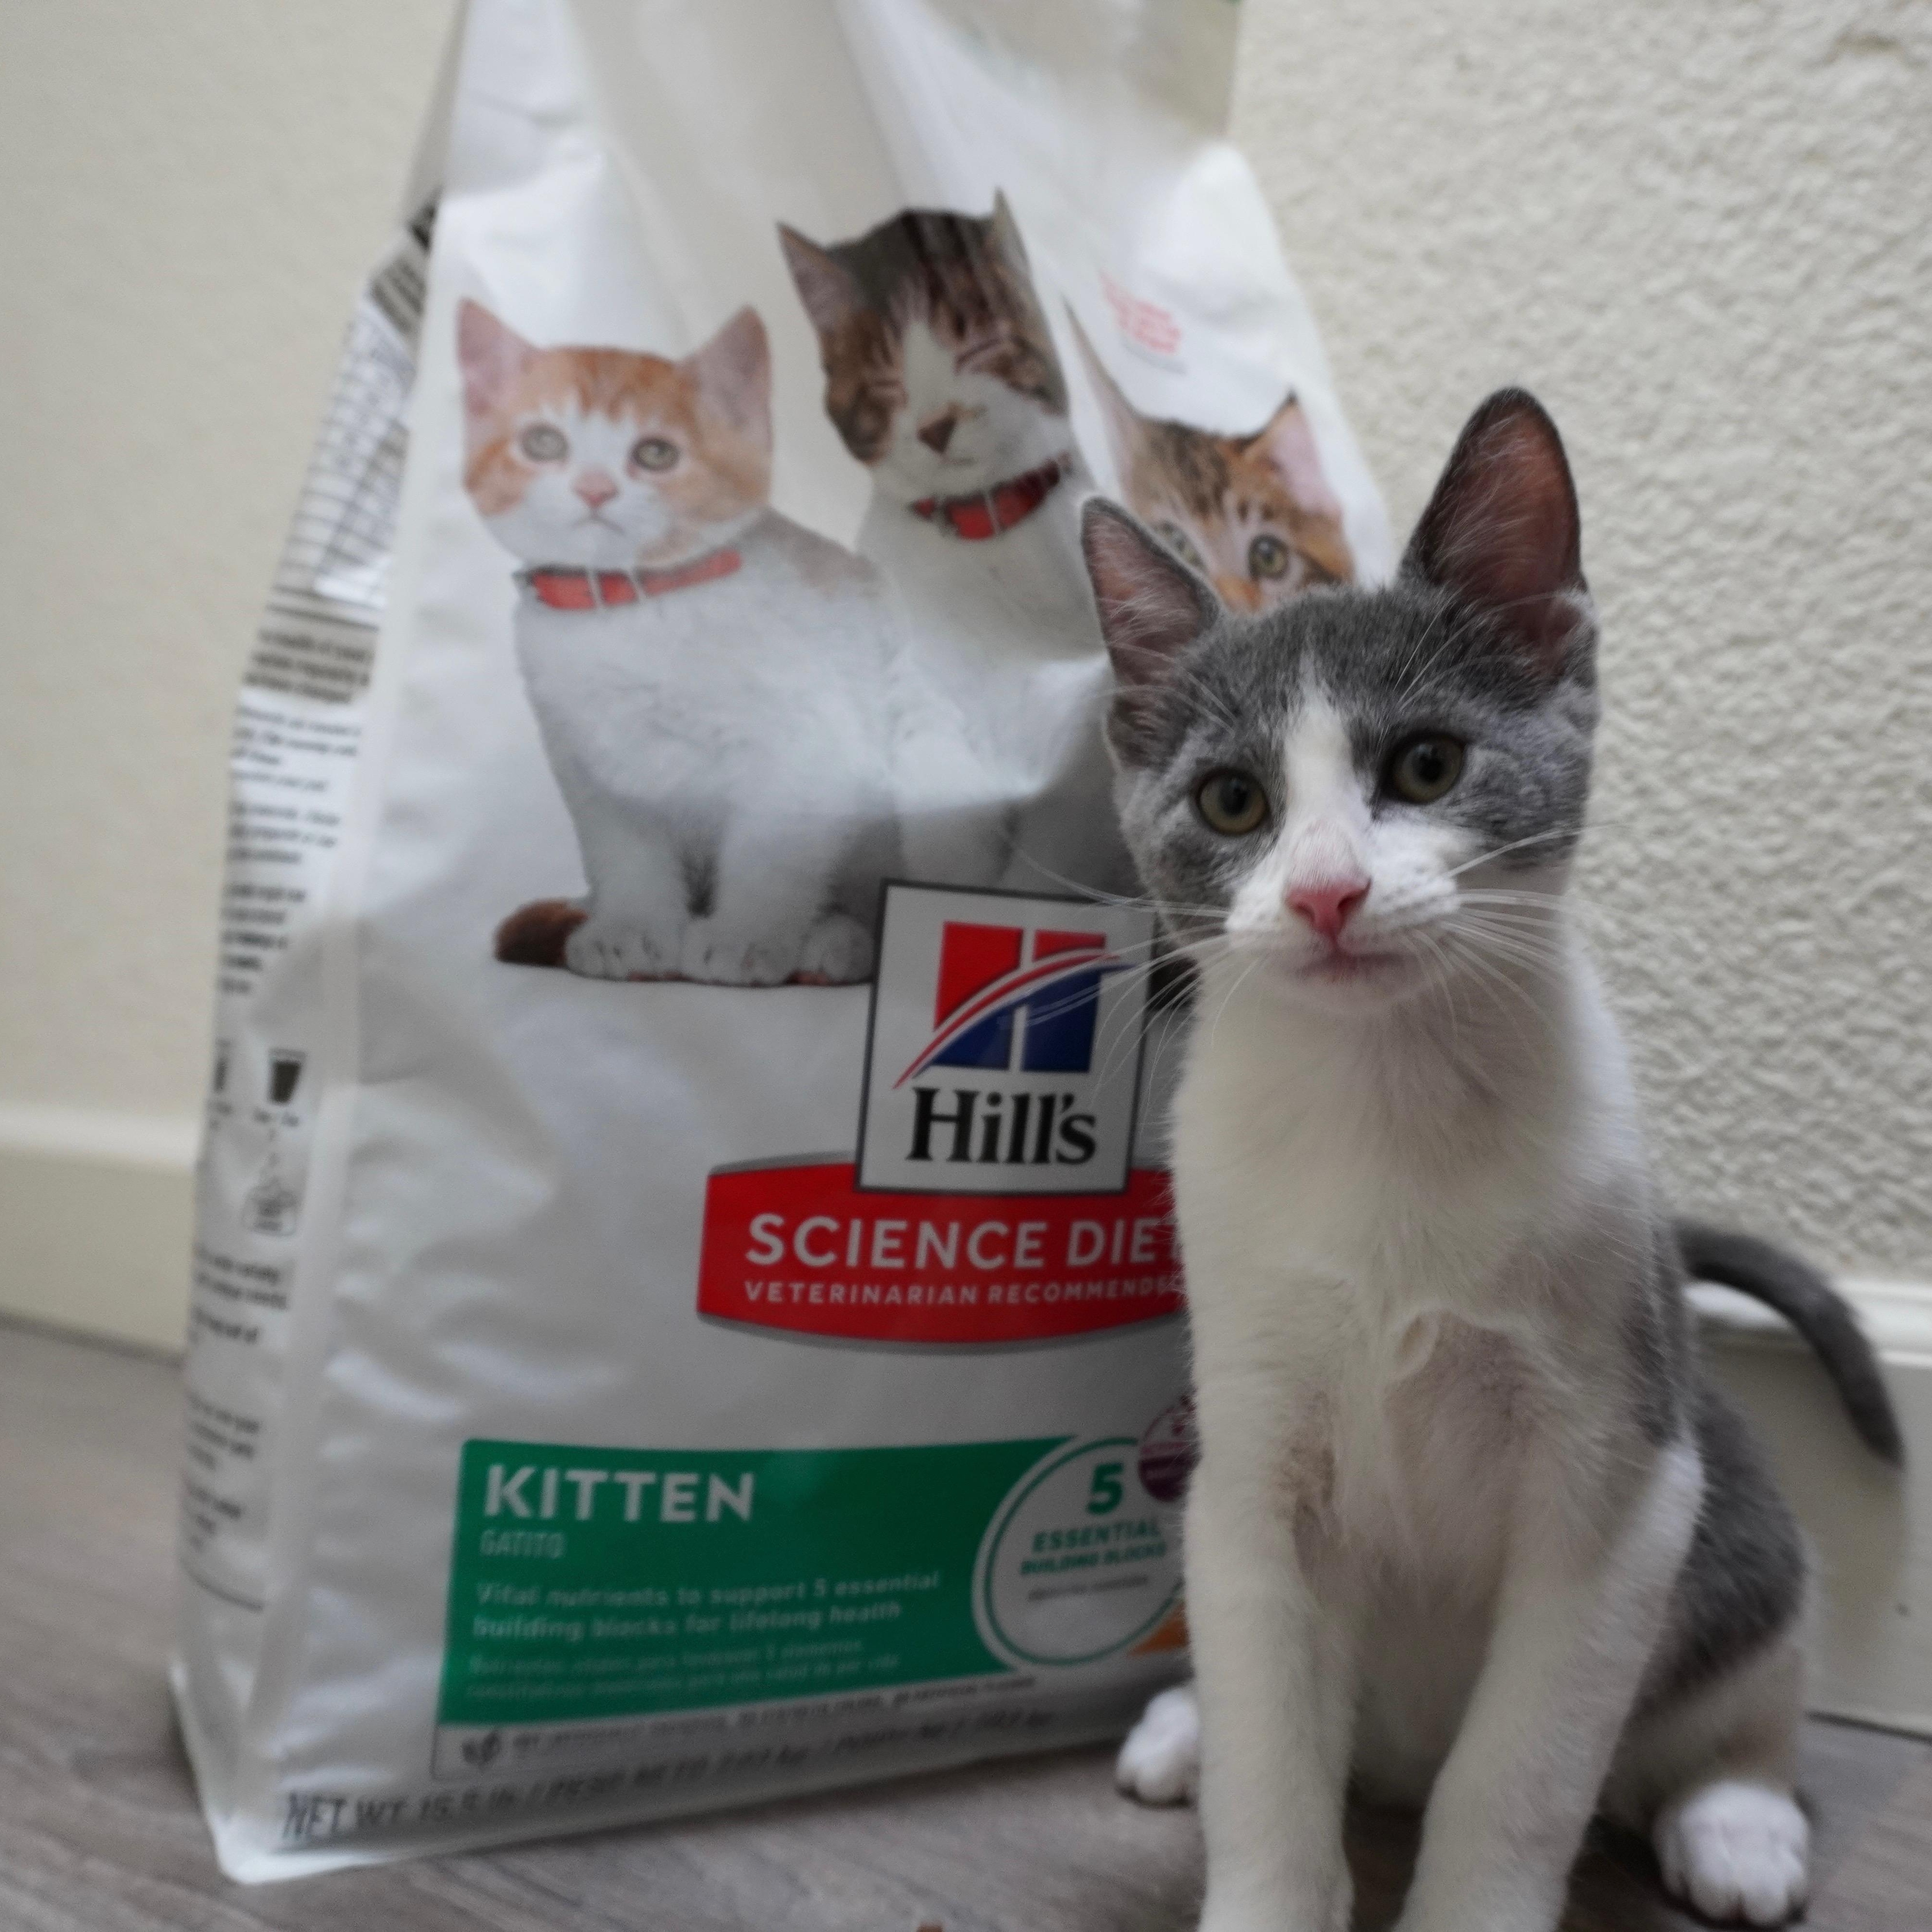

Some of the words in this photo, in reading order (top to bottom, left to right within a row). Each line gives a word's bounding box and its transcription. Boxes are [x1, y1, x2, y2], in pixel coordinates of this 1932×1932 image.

[905, 1086, 1097, 1165] Hill's
[745, 1213, 1047, 1269] SCIENCE
[743, 1280, 977, 1305] VETERINARIAN
[484, 1463, 755, 1522] KITTEN
[1087, 1462, 1123, 1515] 5
[479, 1529, 566, 1559] GATITO
[1034, 1520, 1161, 1551] ESSENTIAL
[477, 1581, 540, 1607] Vital
[546, 1587, 669, 1608] nutrients
[677, 1587, 702, 1606] to
[710, 1581, 806, 1608] support
[814, 1576, 827, 1597] 5
[834, 1570, 940, 1596] essential
[473, 1615, 585, 1643] building
[591, 1618, 676, 1638] blocks
[684, 1613, 721, 1634] for
[730, 1609, 822, 1632] lifelong
[830, 1599, 902, 1623] health
